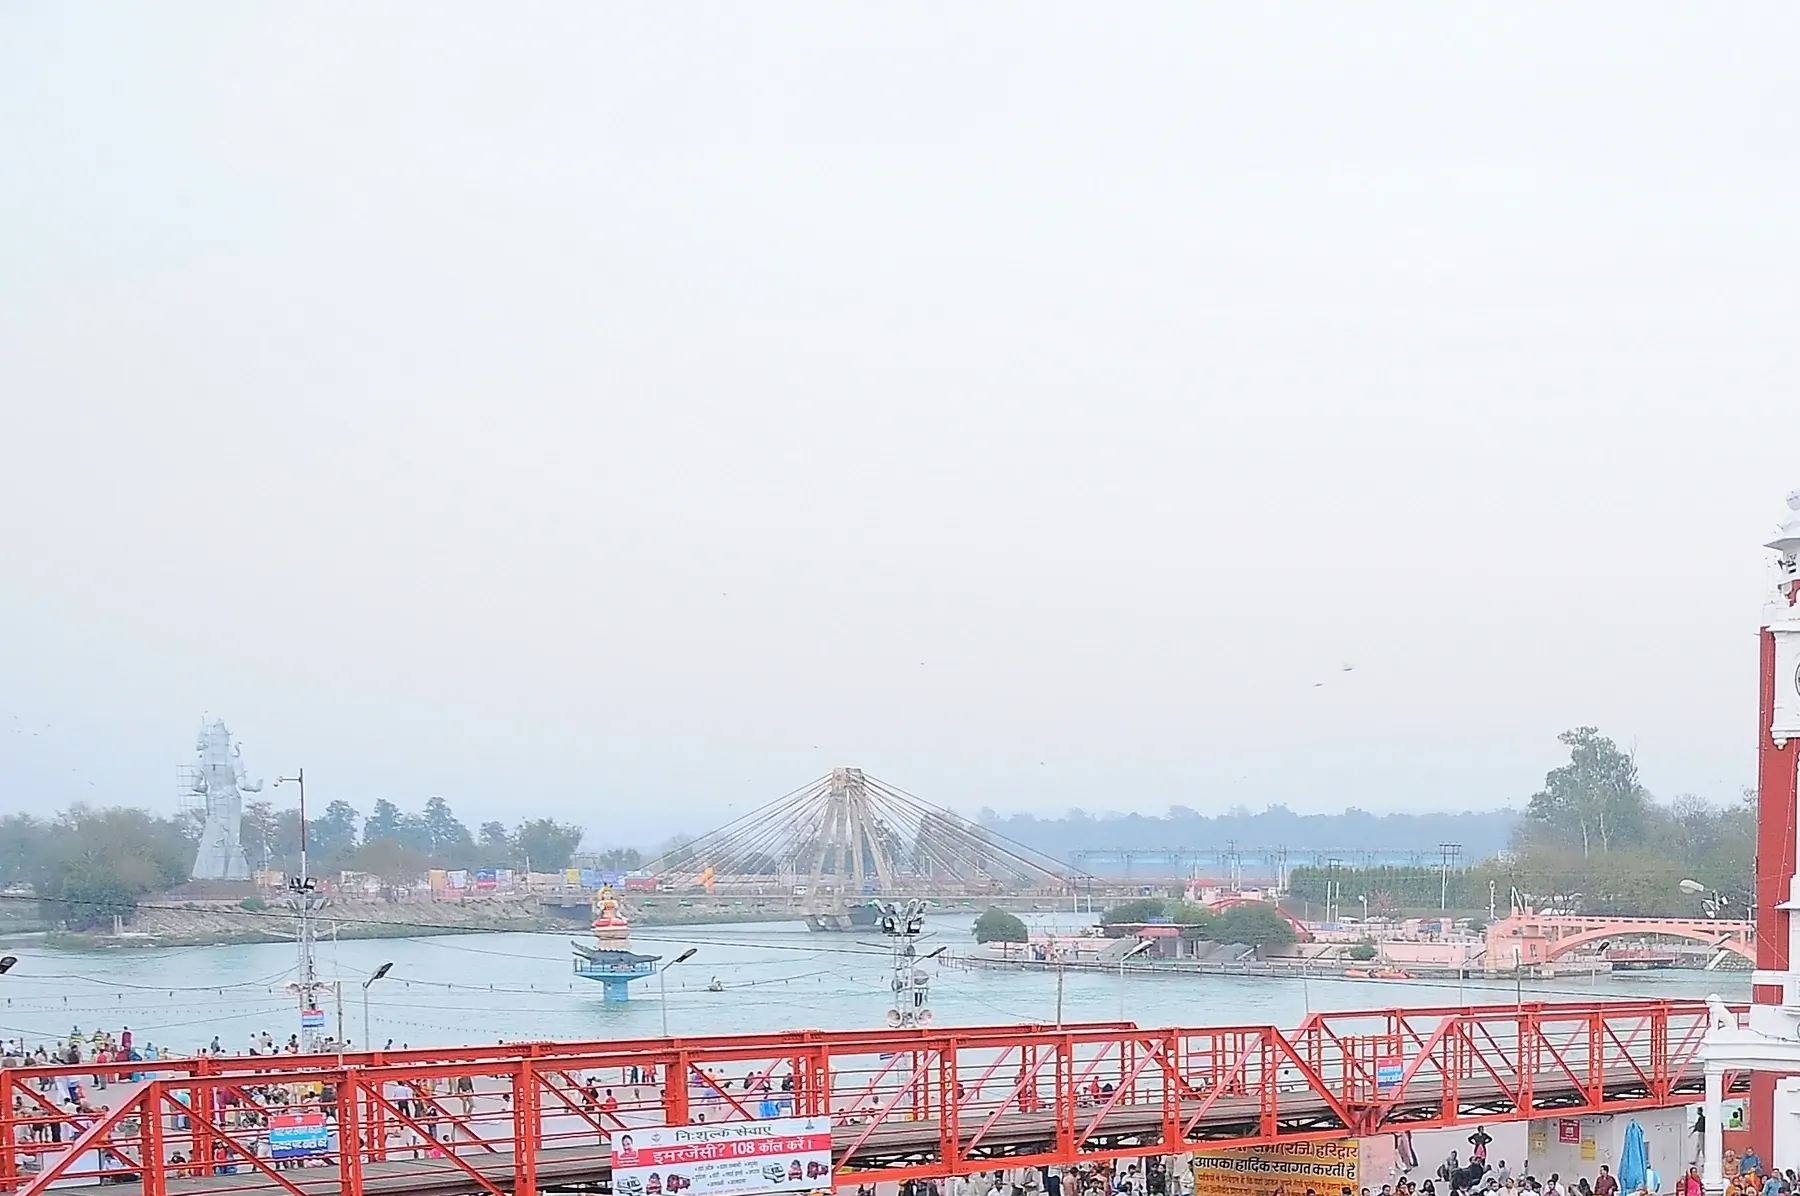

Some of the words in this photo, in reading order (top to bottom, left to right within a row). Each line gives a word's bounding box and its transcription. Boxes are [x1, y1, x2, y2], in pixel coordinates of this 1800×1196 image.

[730, 1139, 755, 1156] 108
[759, 1138, 782, 1153] कॉल
[1316, 1142, 1358, 1161] हरिद्वार
[1195, 1157, 1234, 1171] आपका
[1236, 1156, 1270, 1174] हार्दिक
[1272, 1160, 1310, 1174] स्वागत
[1313, 1162, 1345, 1177] करती
[1346, 1162, 1356, 1180] है
